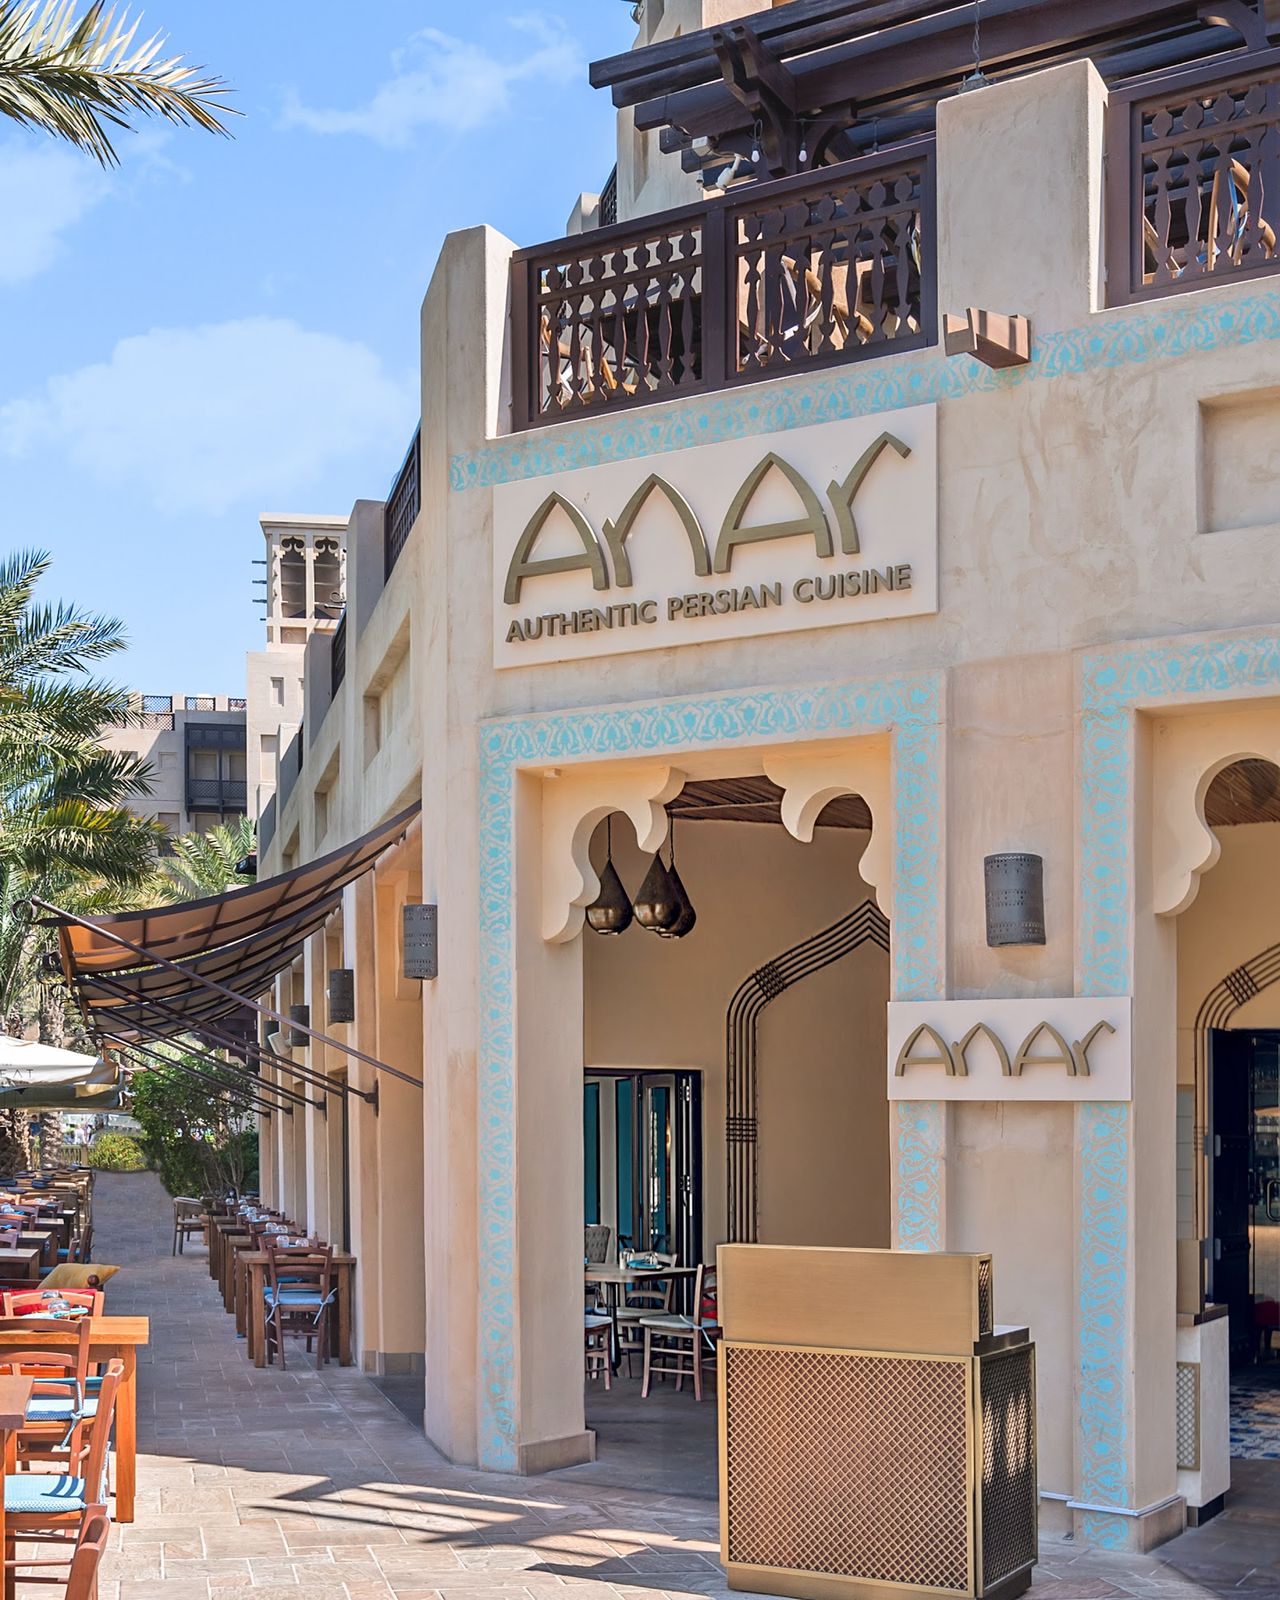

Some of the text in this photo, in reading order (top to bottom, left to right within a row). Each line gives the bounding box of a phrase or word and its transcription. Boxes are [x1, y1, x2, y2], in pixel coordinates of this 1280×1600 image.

[505, 564, 912, 643] AUTHENTIC PERSIAN CUISINE
